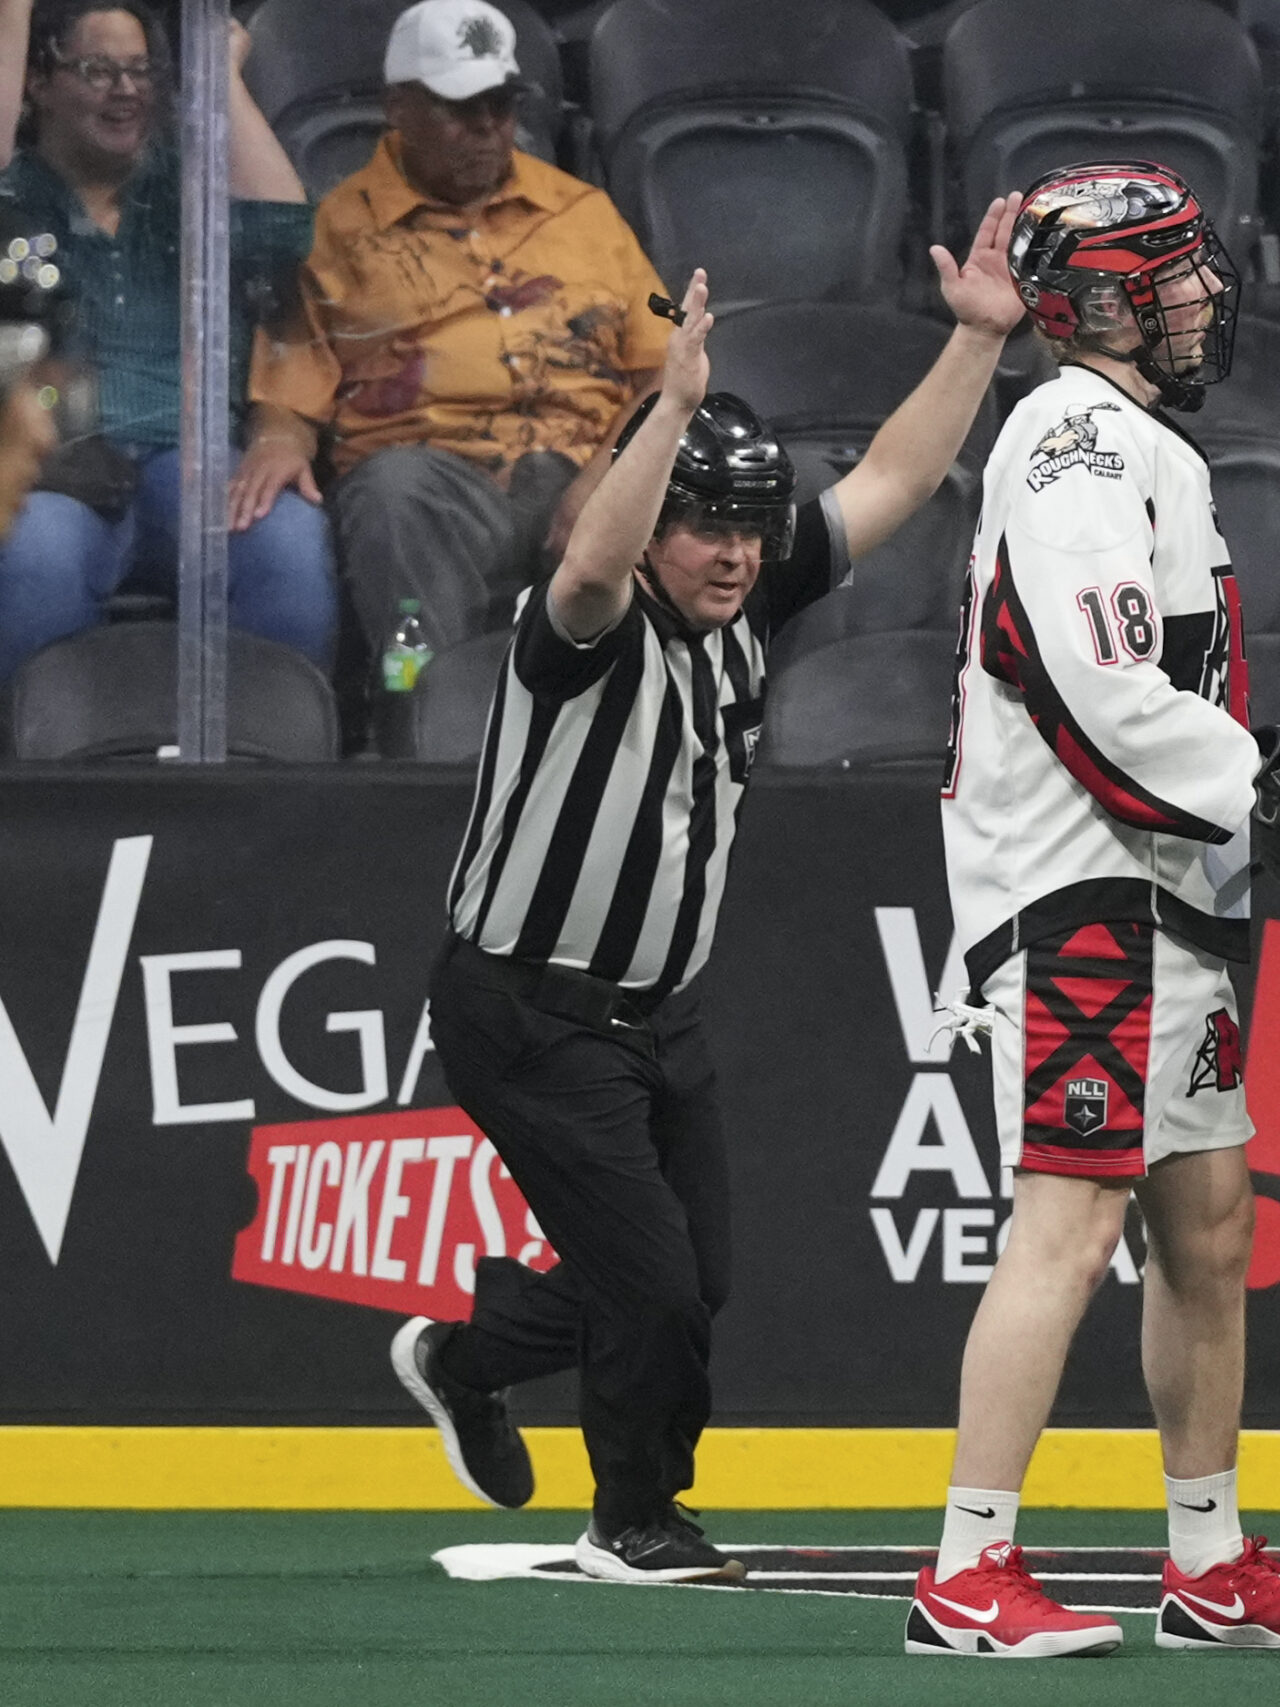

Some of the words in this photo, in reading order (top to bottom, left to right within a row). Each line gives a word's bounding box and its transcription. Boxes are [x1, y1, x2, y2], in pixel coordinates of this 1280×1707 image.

[1026, 444, 1125, 493] ROUGHNECKS
[1076, 580, 1158, 666] 18
[1067, 1081, 1105, 1097] NLL
[260, 1134, 512, 1294] TICKETS
